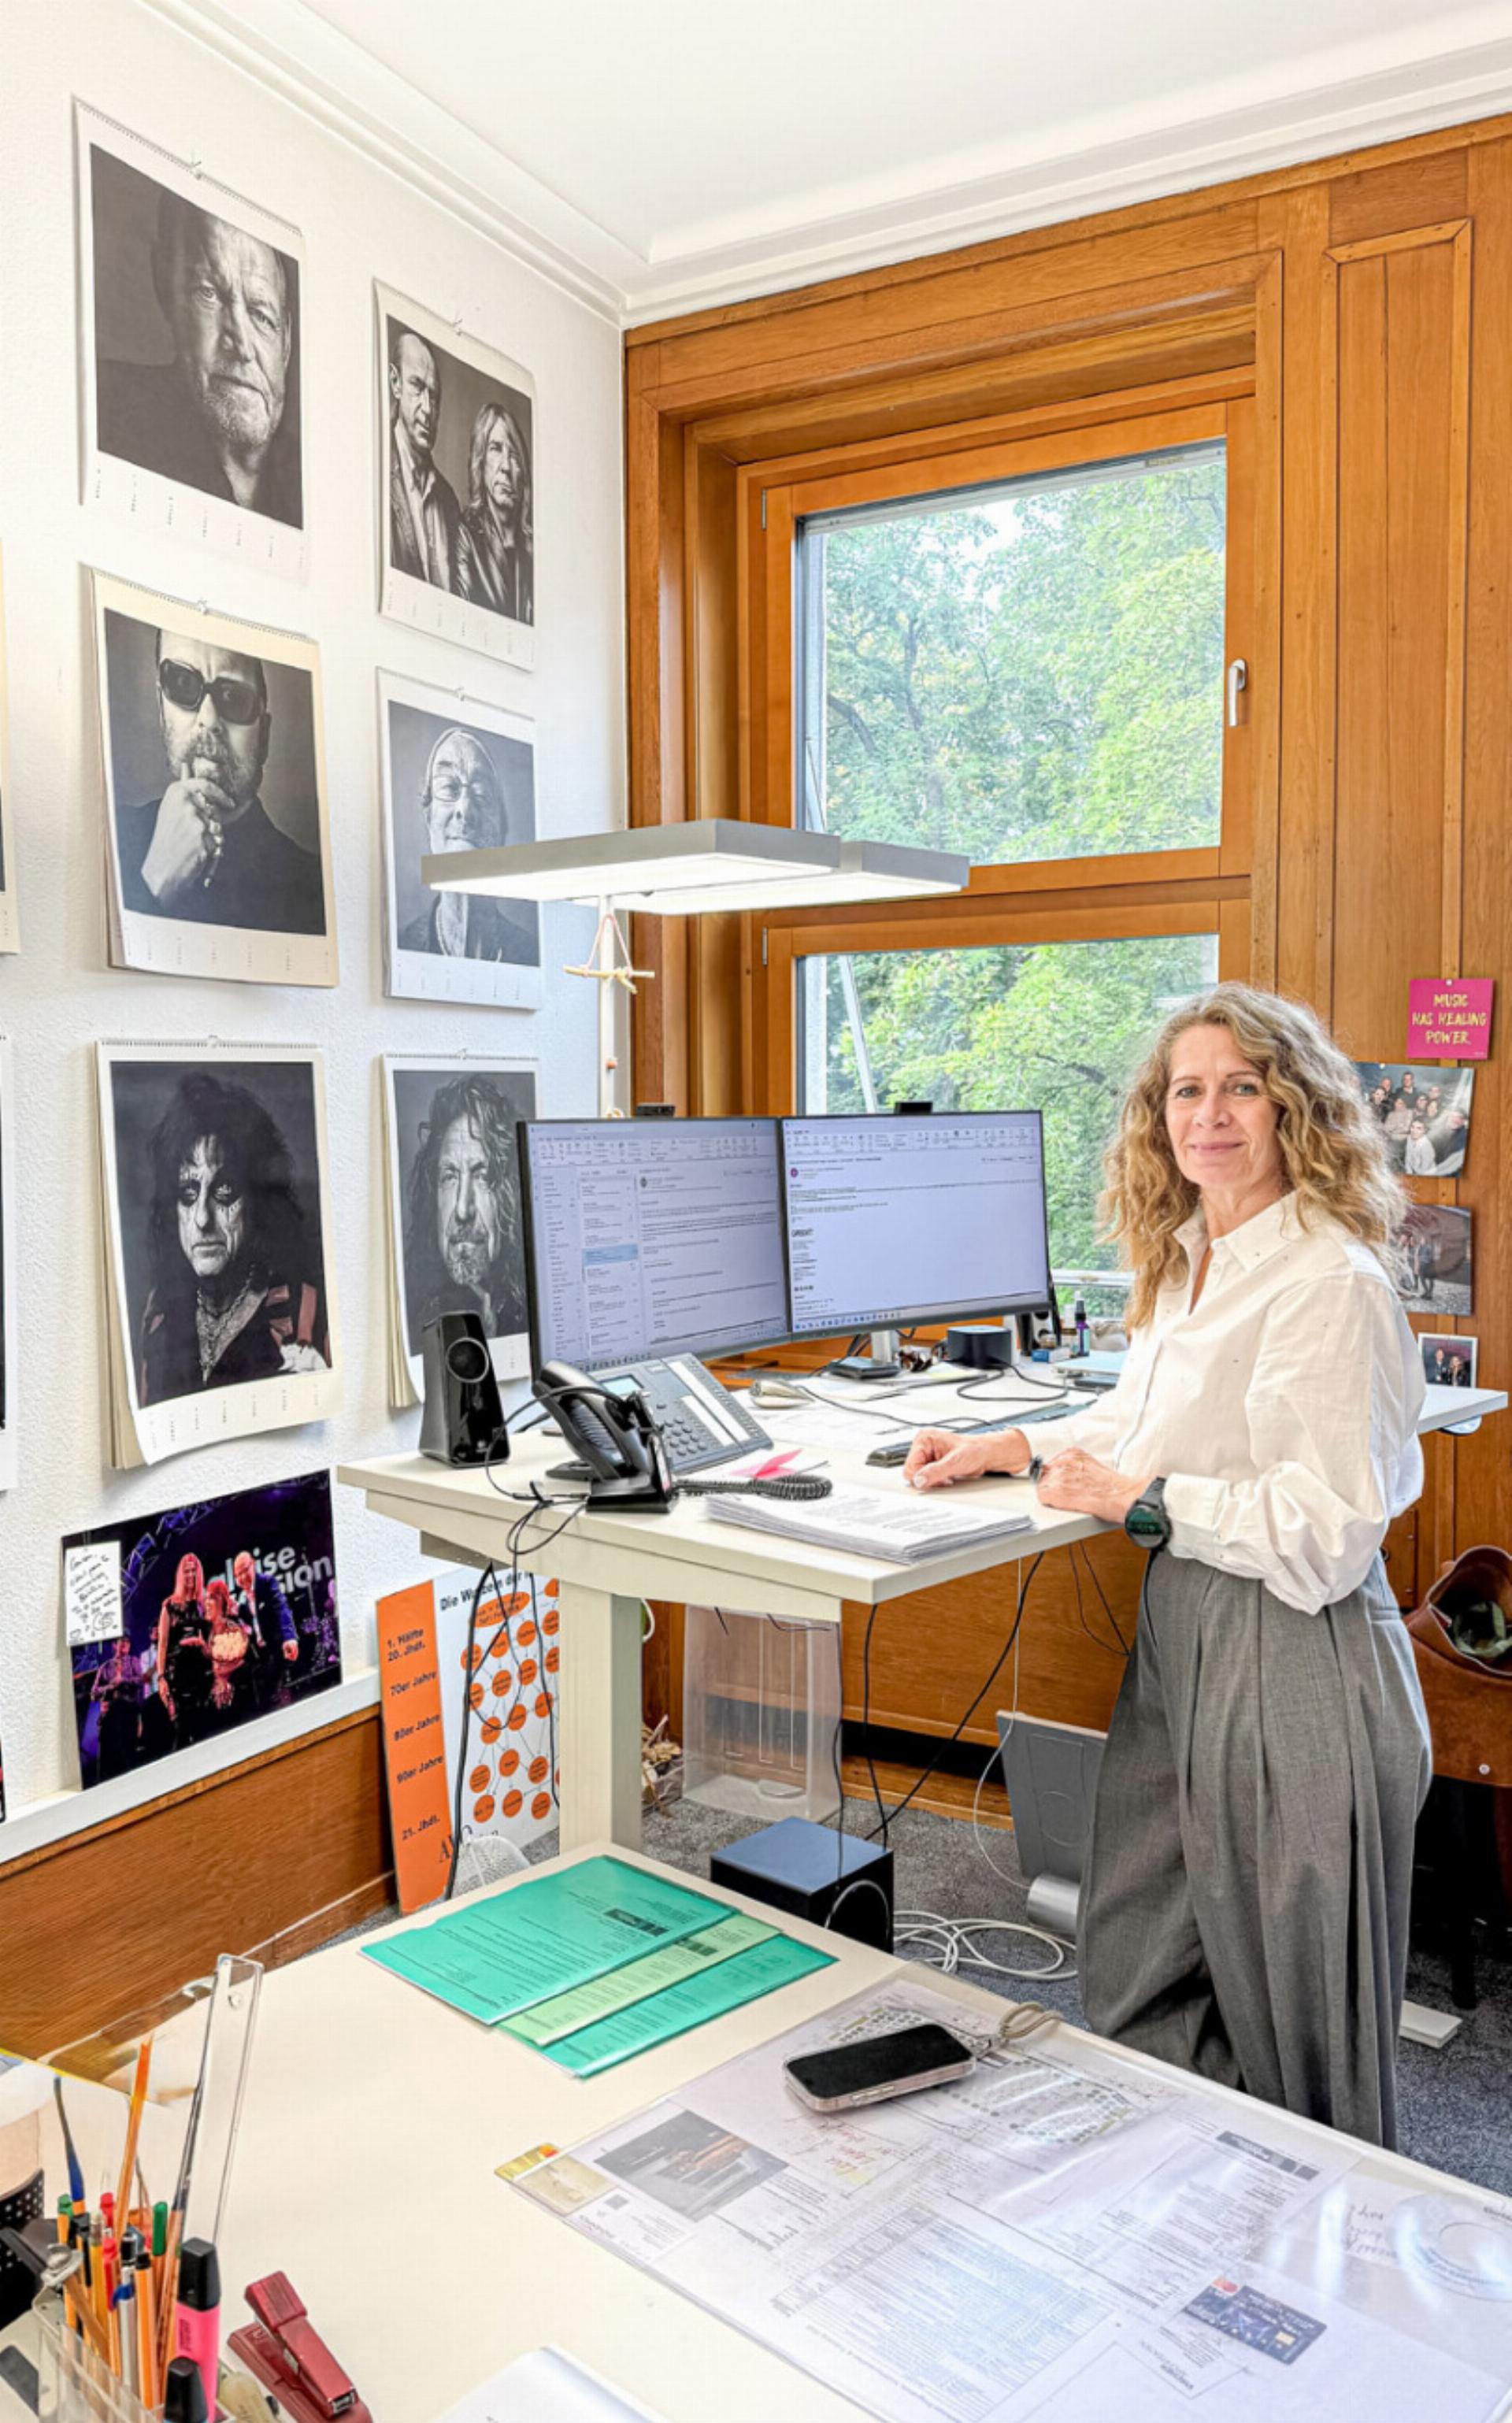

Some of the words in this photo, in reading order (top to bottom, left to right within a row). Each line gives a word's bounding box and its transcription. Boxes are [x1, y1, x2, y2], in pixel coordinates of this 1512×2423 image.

[1434, 994, 1468, 1007] MUSIC
[1411, 1012, 1433, 1025] HAS
[1438, 1012, 1487, 1027] HEALING
[440, 1596, 458, 1610] Die
[506, 1572, 522, 1586] dr
[390, 1682, 410, 1696] 70er
[413, 1671, 436, 1687] Jahre
[394, 1725, 414, 1741] 80er
[416, 1714, 440, 1730] Jahre
[418, 1755, 443, 1773] Jahre
